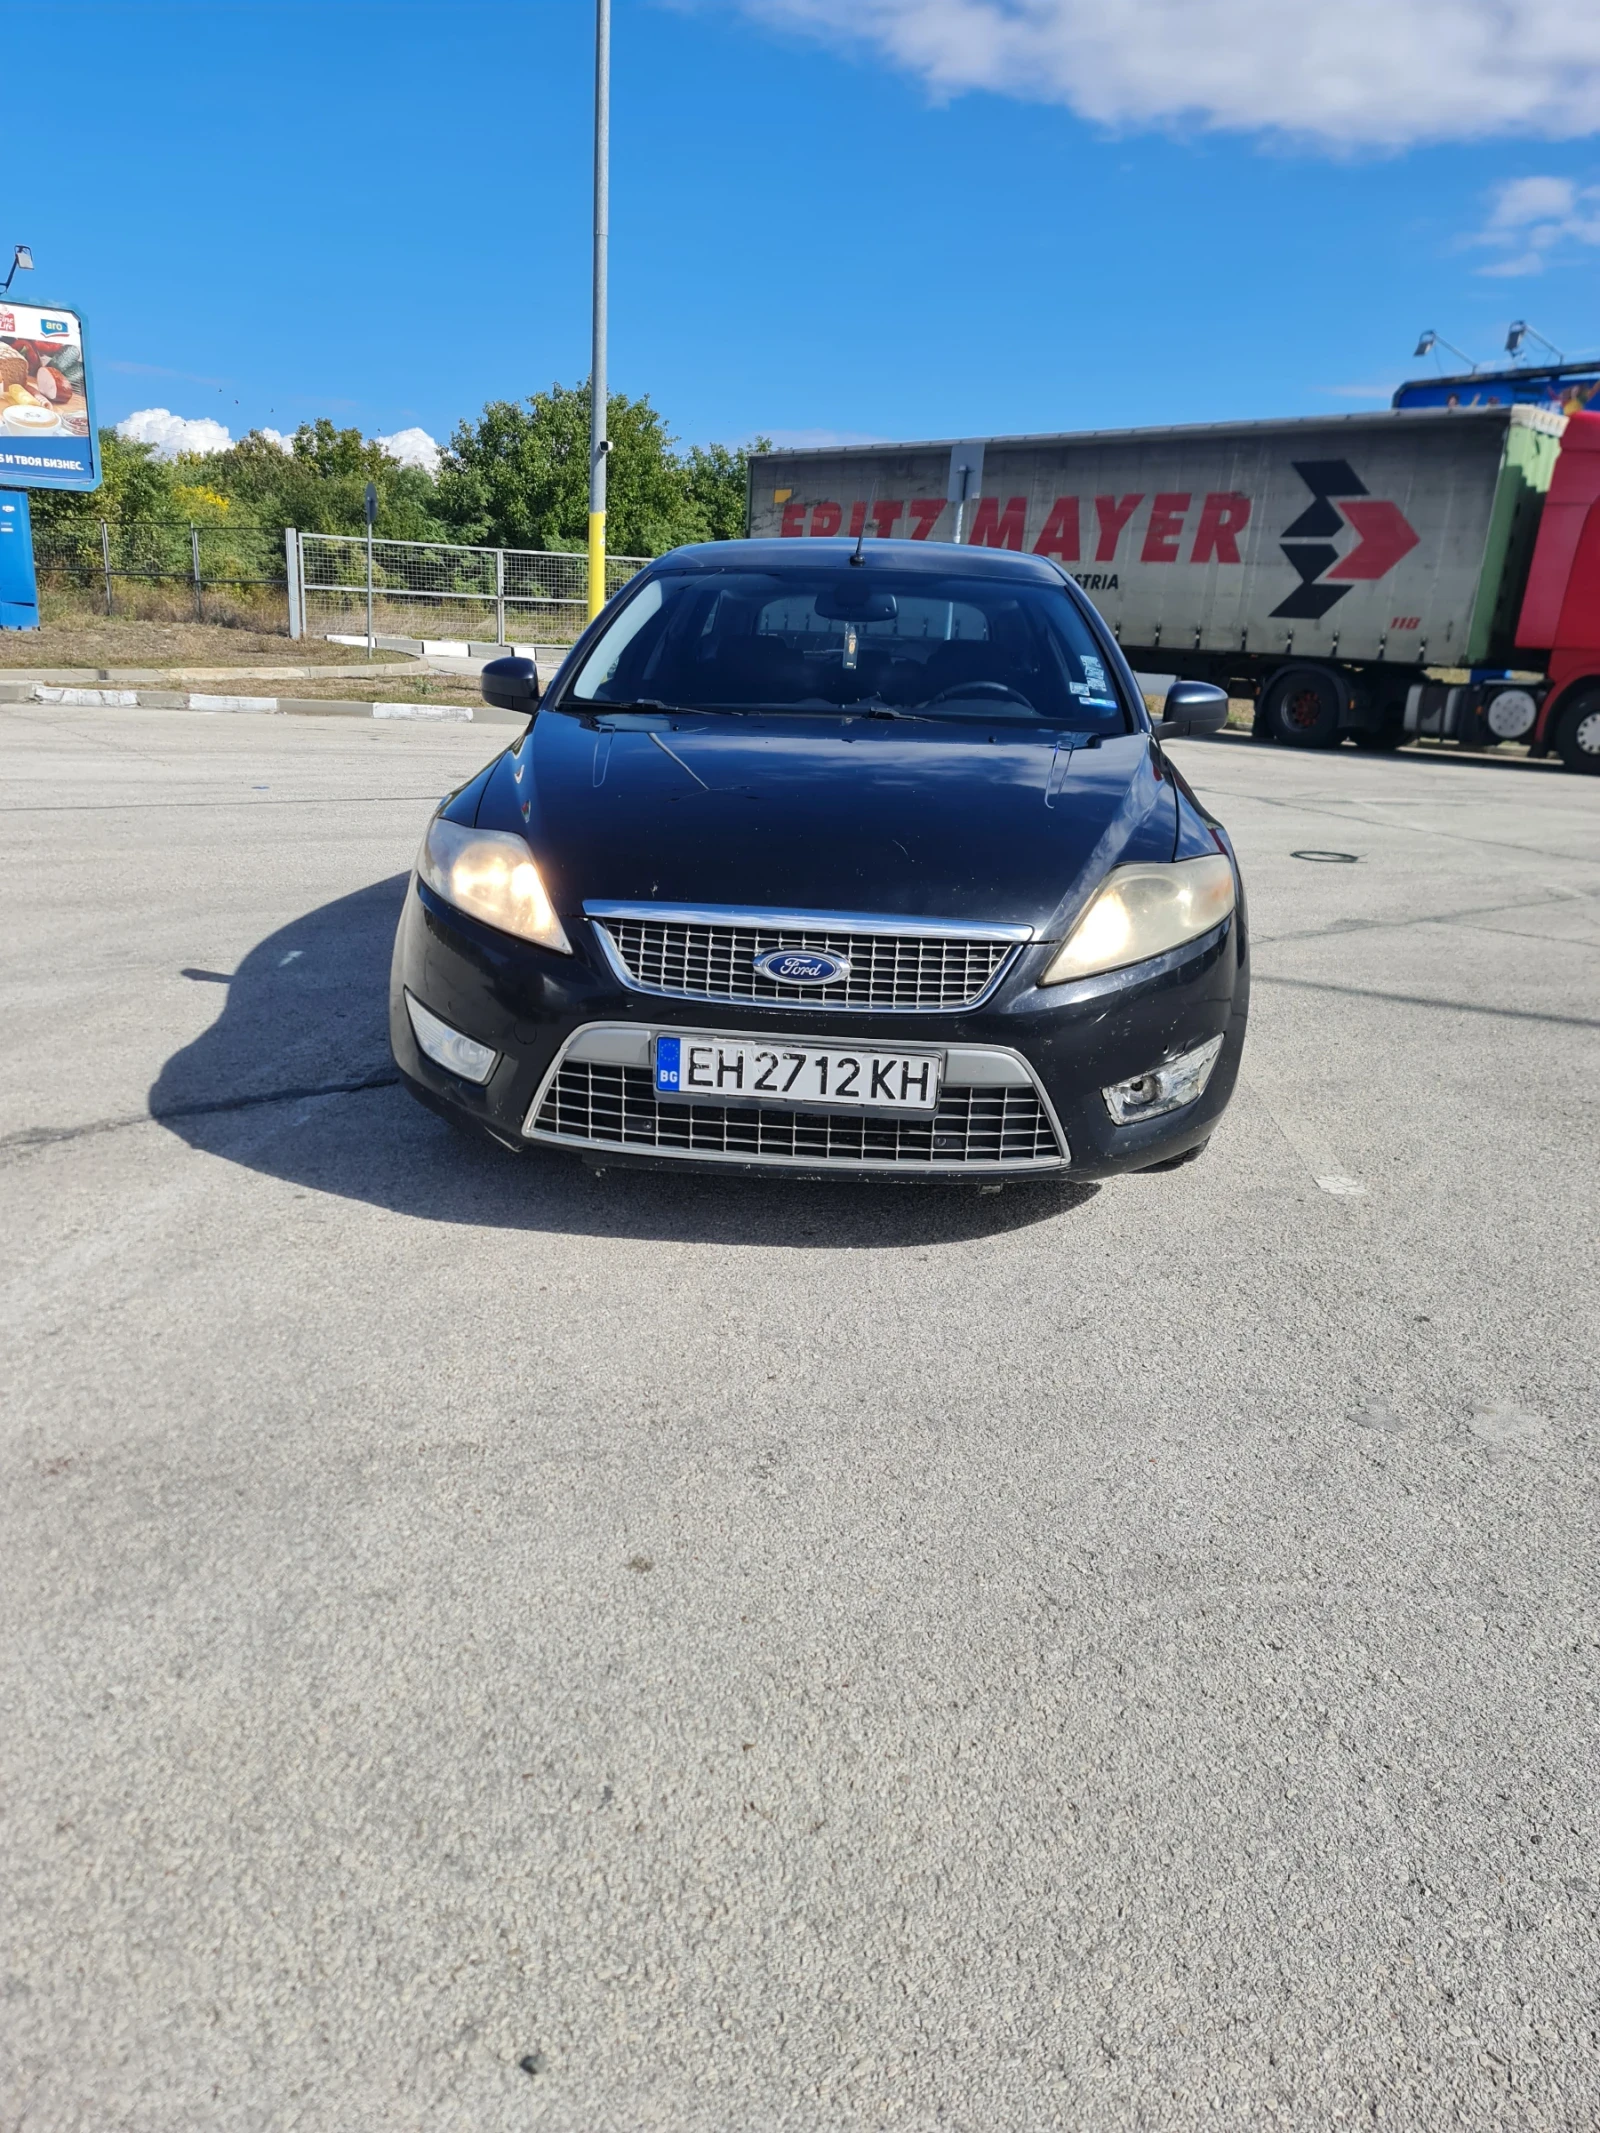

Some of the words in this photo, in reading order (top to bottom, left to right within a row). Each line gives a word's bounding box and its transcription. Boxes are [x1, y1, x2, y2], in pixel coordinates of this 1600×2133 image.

[46, 321, 63, 331] aro
[5, 453, 14, 464] И
[14, 455, 42, 467] ТВОЯ
[43, 457, 85, 471] БИЗНЕС.
[967, 492, 1251, 564] MAYER
[780, 957, 822, 976] Ford
[660, 1070, 678, 1083] BG
